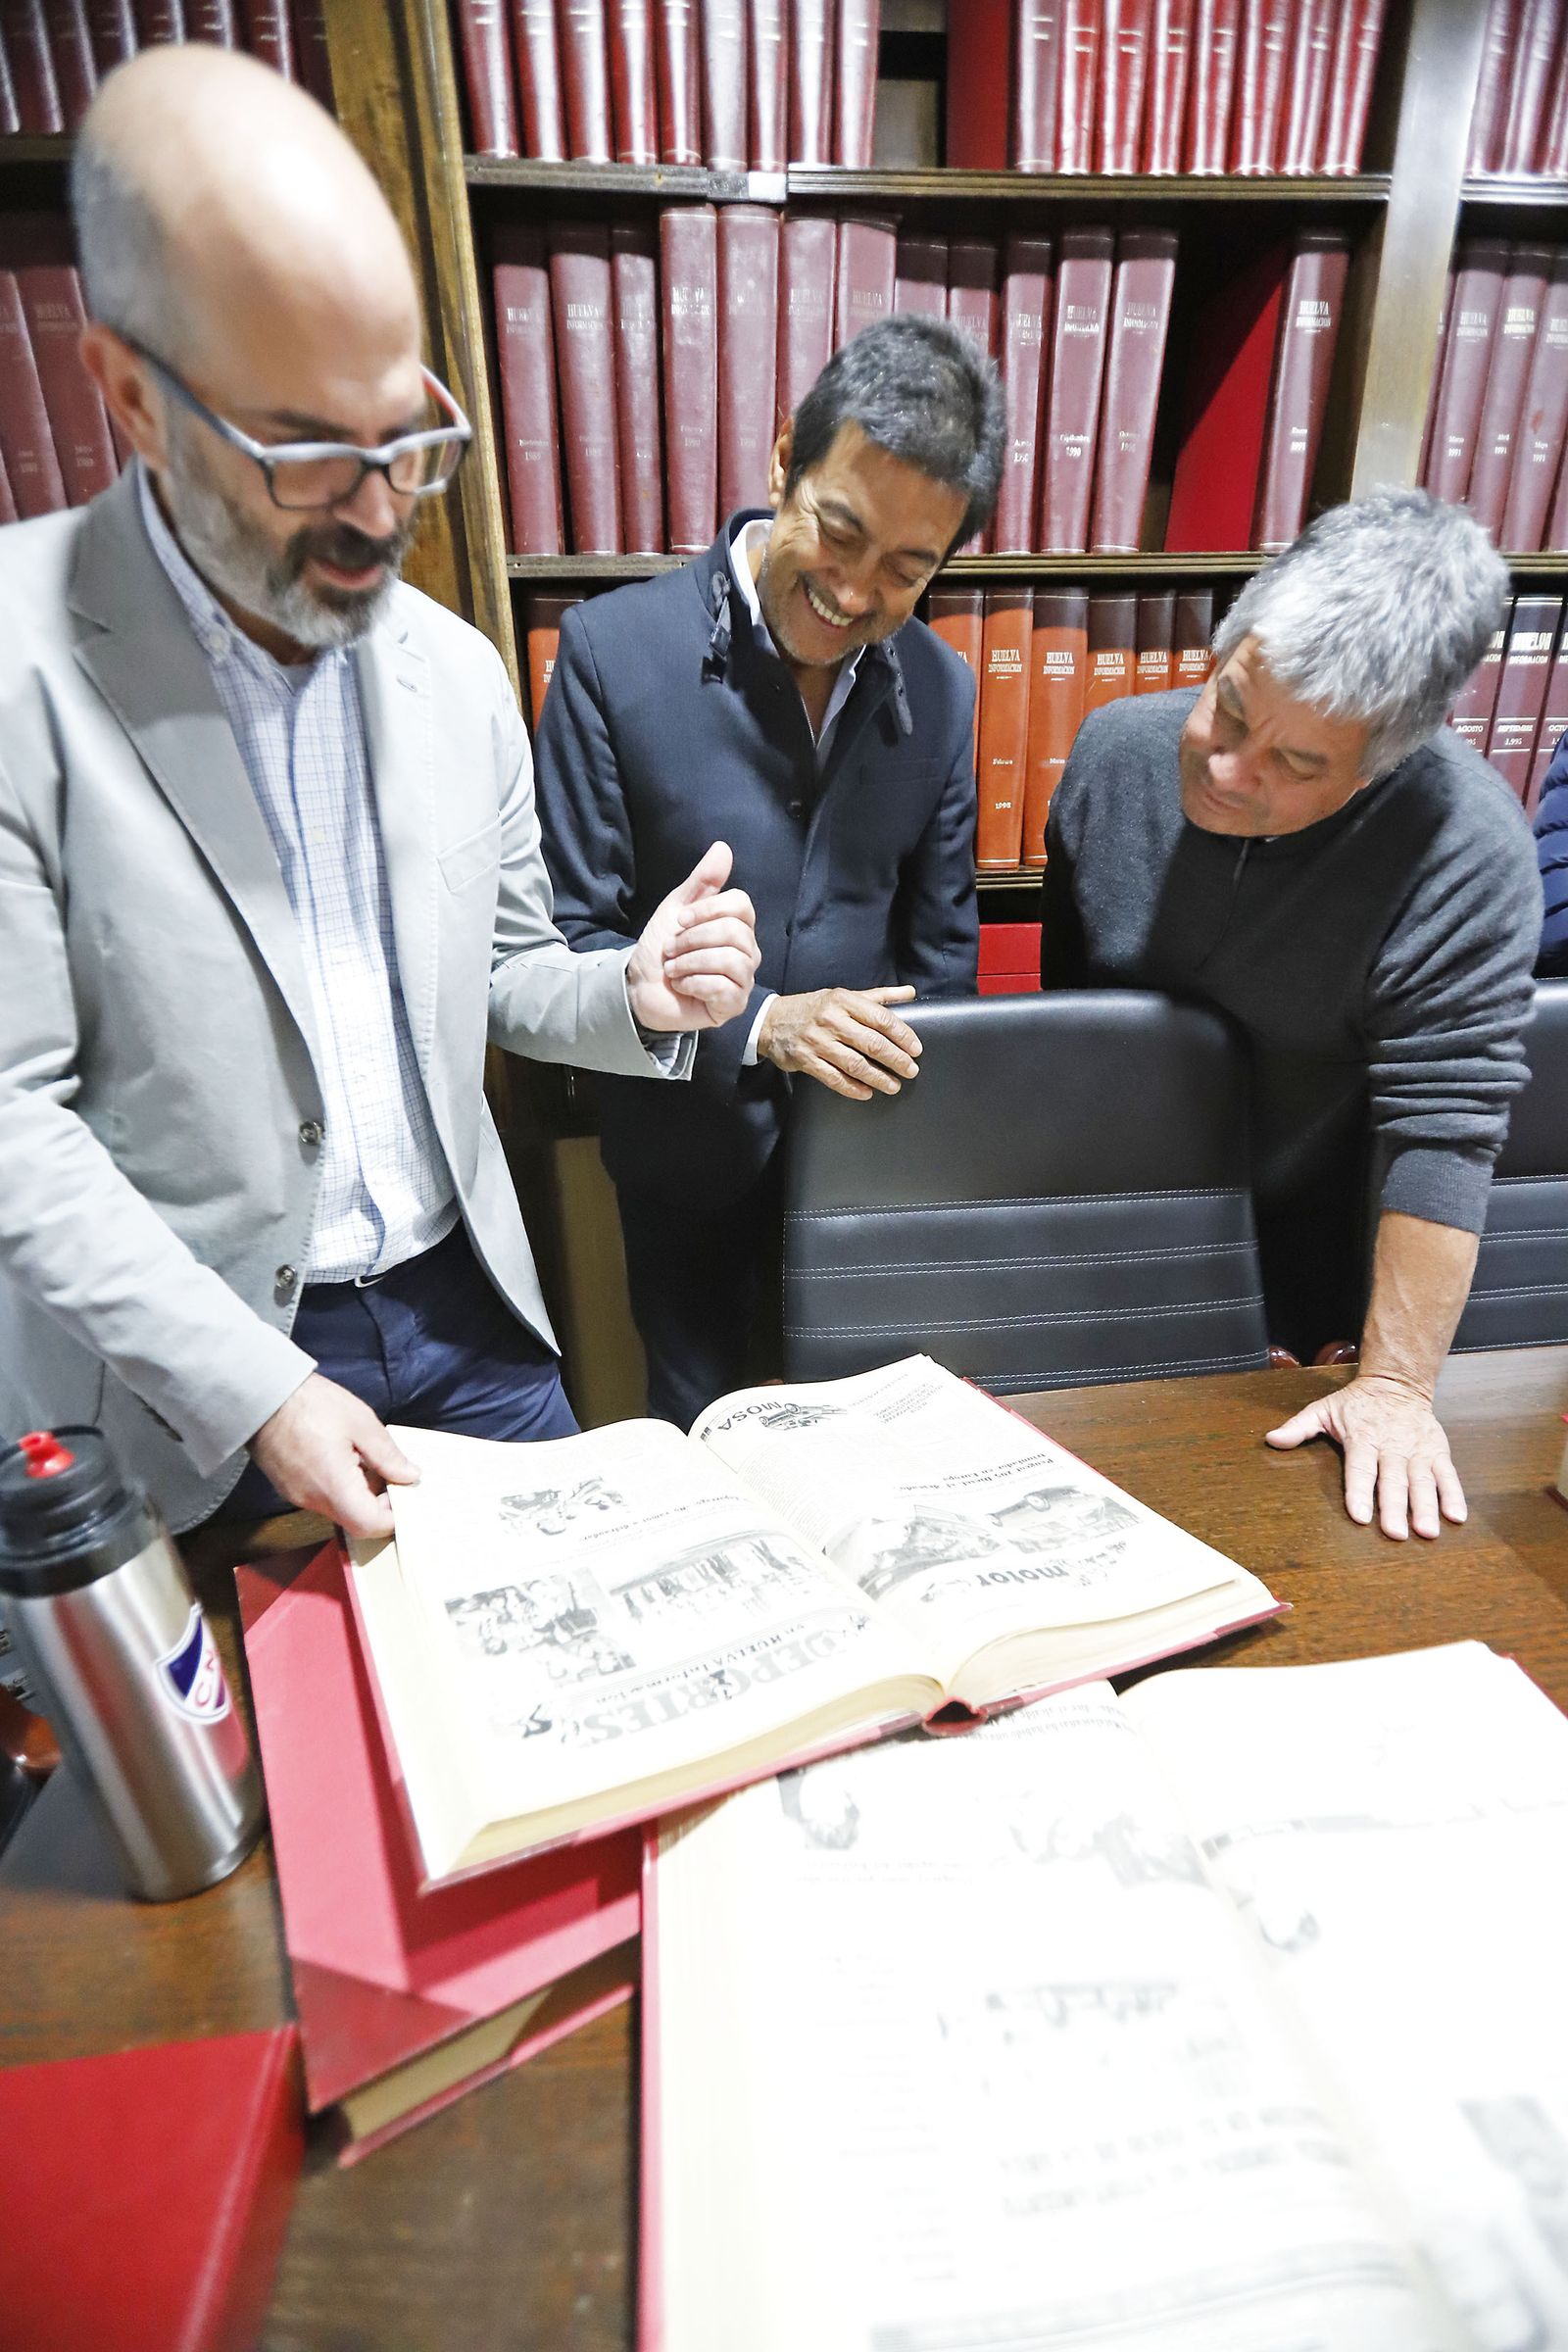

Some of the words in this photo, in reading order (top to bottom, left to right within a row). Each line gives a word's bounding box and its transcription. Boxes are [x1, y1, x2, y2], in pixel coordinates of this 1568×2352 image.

[1298, 301, 1330, 316] HUELVA
[1507, 308, 1535, 322] HUELVA
[991, 649, 1021, 662] HUELVA
[1046, 652, 1074, 664] HUELVA
[1097, 653, 1124, 665] HUELVA
[1140, 651, 1168, 663] HUELVA
[1182, 649, 1209, 662] HUELVA
[988, 662, 1023, 673] INFORMACION
[1043, 665, 1075, 675] INFORMACION
[1094, 665, 1126, 676] INFORMACION
[1137, 664, 1169, 674] INFORMACION
[717, 1400, 782, 1433] MOSA
[974, 1565, 1070, 1589] motor
[711, 1634, 783, 1667] HUELVA
[582, 1630, 847, 1747] DEPORTES
